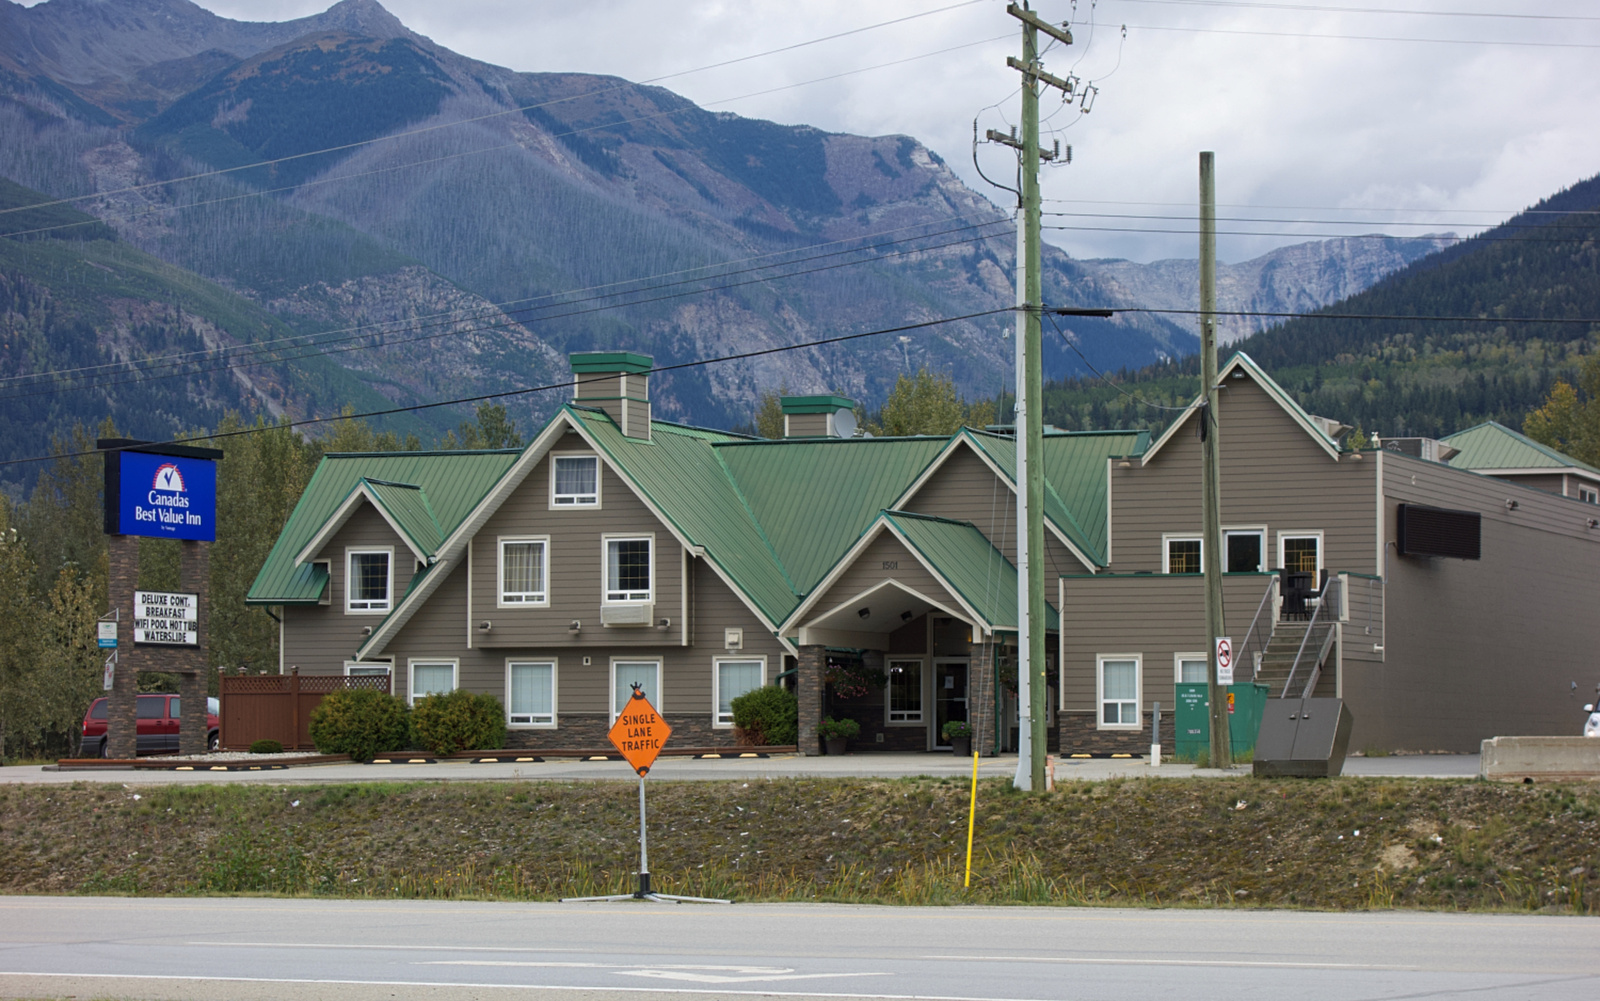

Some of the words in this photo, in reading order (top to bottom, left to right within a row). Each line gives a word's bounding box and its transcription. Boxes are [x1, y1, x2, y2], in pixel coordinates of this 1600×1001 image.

[148, 490, 189, 508] Canadas
[136, 506, 156, 521] Best
[158, 508, 184, 523] Value
[186, 511, 201, 525] Inn
[882, 561, 898, 570] 1501
[142, 594, 167, 604] DELUXE
[170, 596, 190, 607] CONT.
[146, 607, 186, 618] BREAKFAST
[135, 619, 149, 629] WIFI
[151, 619, 168, 630] POOL
[144, 631, 186, 643] WATERSLIDE
[623, 714, 655, 725] SINGLE
[628, 727, 652, 738] LANE
[622, 739, 659, 752] TRAFFIC
